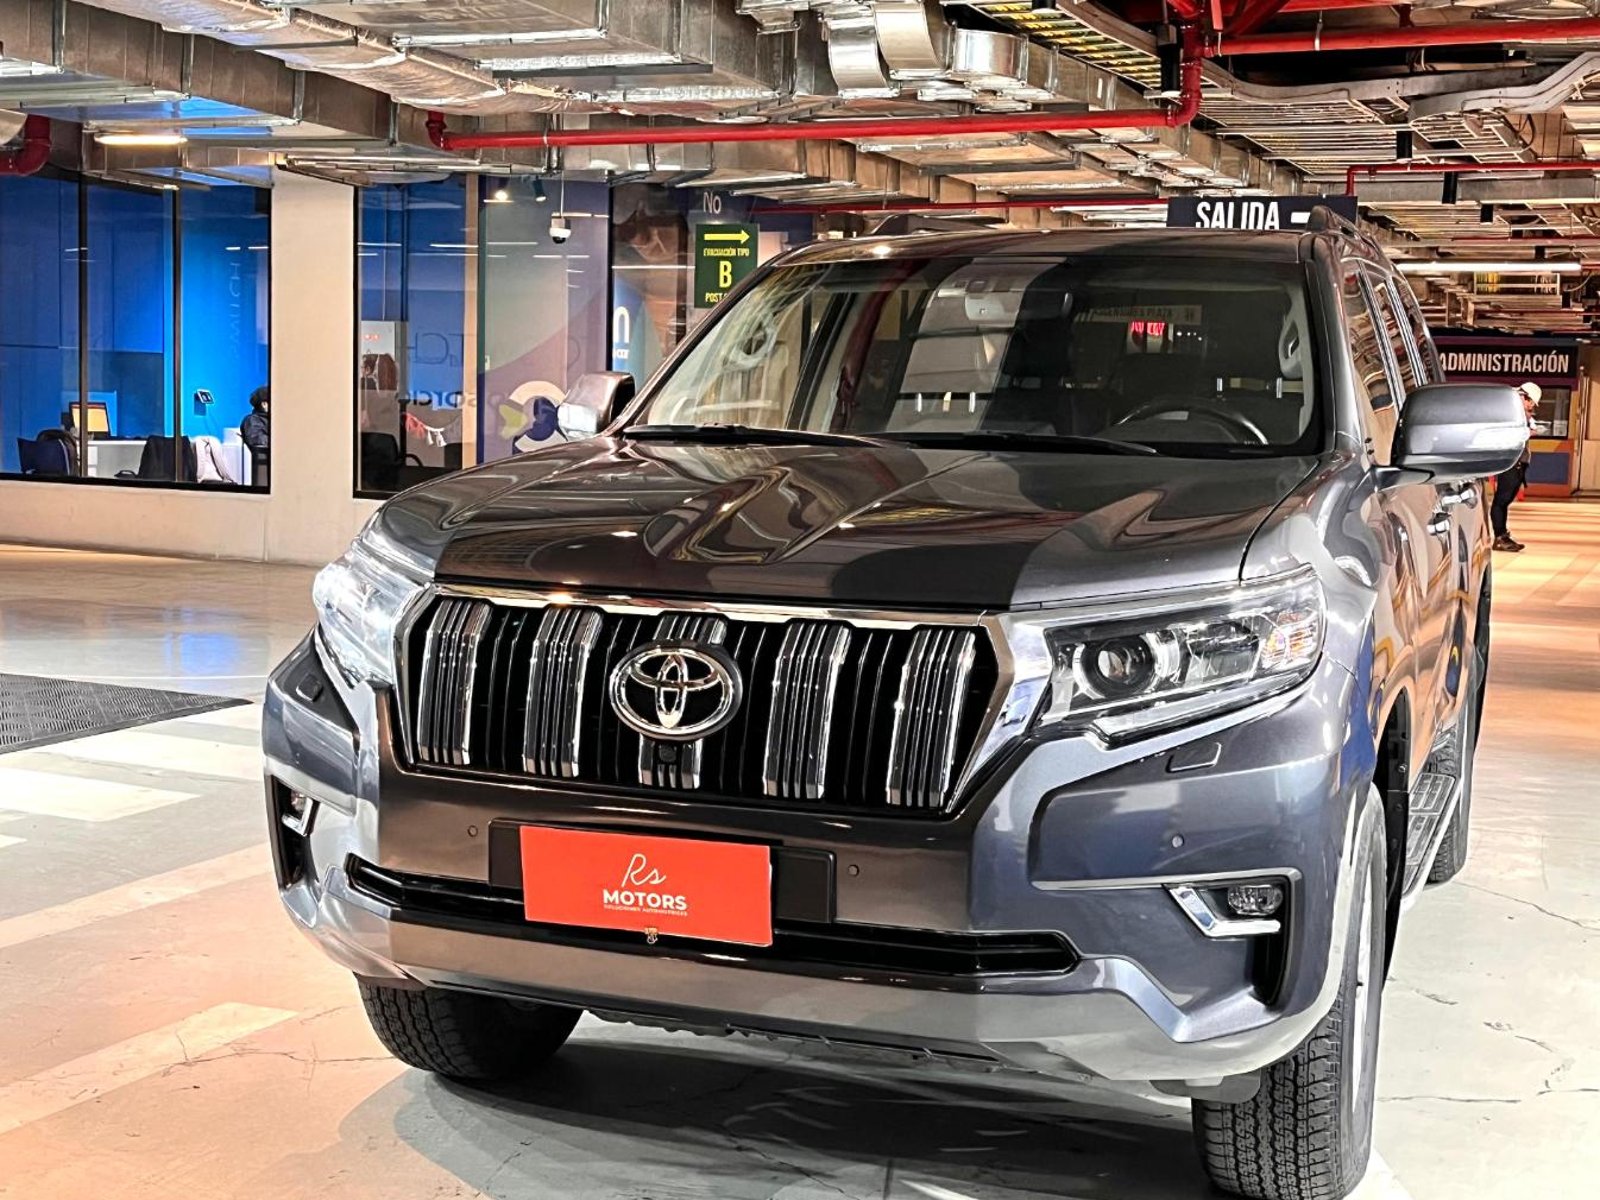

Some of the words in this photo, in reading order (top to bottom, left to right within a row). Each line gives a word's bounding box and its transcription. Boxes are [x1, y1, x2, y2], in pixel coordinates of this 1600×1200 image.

[703, 191, 722, 214] No
[1195, 201, 1280, 230] SALIDA
[719, 260, 732, 288] B
[1439, 350, 1569, 373] ADMINISTRACIÓN
[621, 853, 667, 888] Rs
[603, 889, 688, 911] MOTORS
